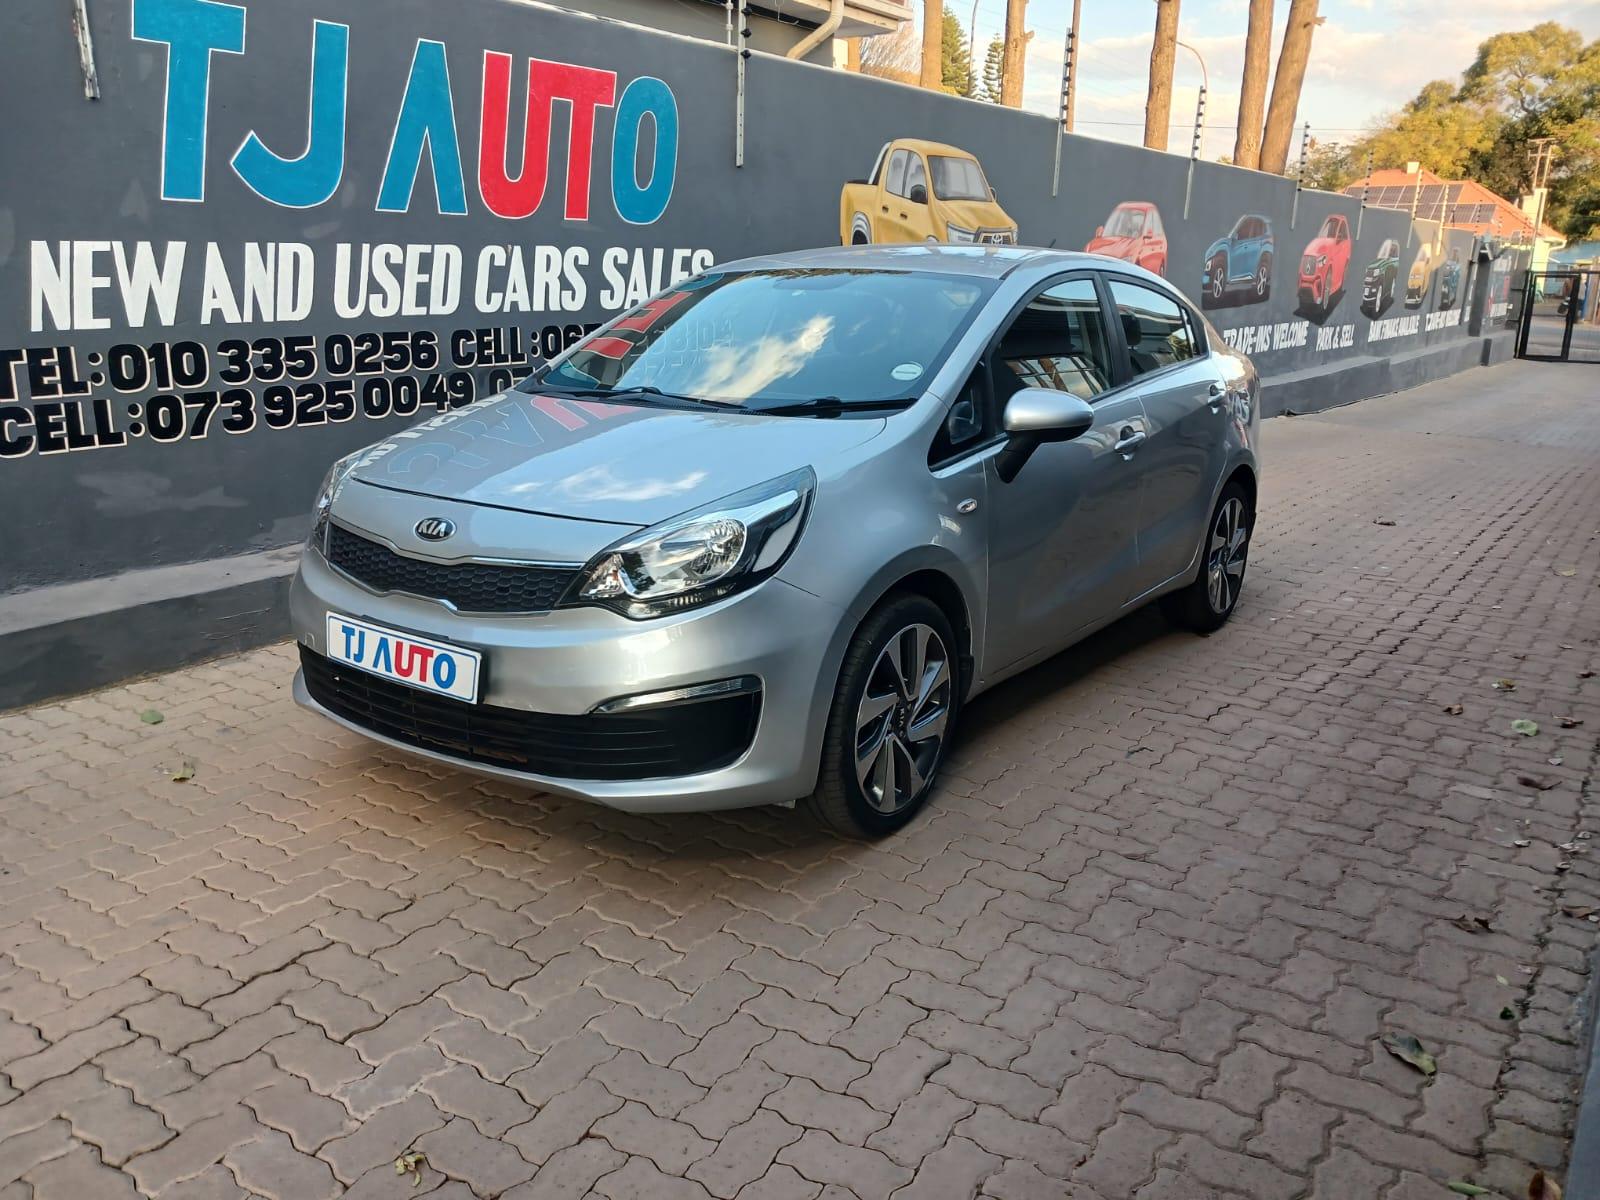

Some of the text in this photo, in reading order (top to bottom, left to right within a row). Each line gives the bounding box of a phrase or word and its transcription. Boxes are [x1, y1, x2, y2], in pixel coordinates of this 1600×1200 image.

[131, 0, 679, 225] TJ AUTO
[31, 240, 186, 331] NEW
[200, 242, 314, 324] AND
[333, 243, 462, 319] USED
[474, 245, 589, 312] CARS
[217, 334, 318, 386] 335
[324, 330, 439, 377] 0256
[1272, 320, 1310, 350] WELCOME
[1316, 326, 1335, 352] PARK
[1340, 323, 1355, 348] SELL
[263, 379, 357, 430] 925
[362, 371, 476, 419] 0049
[418, 519, 447, 537] KIA
[341, 624, 457, 690] TJ AUTO
